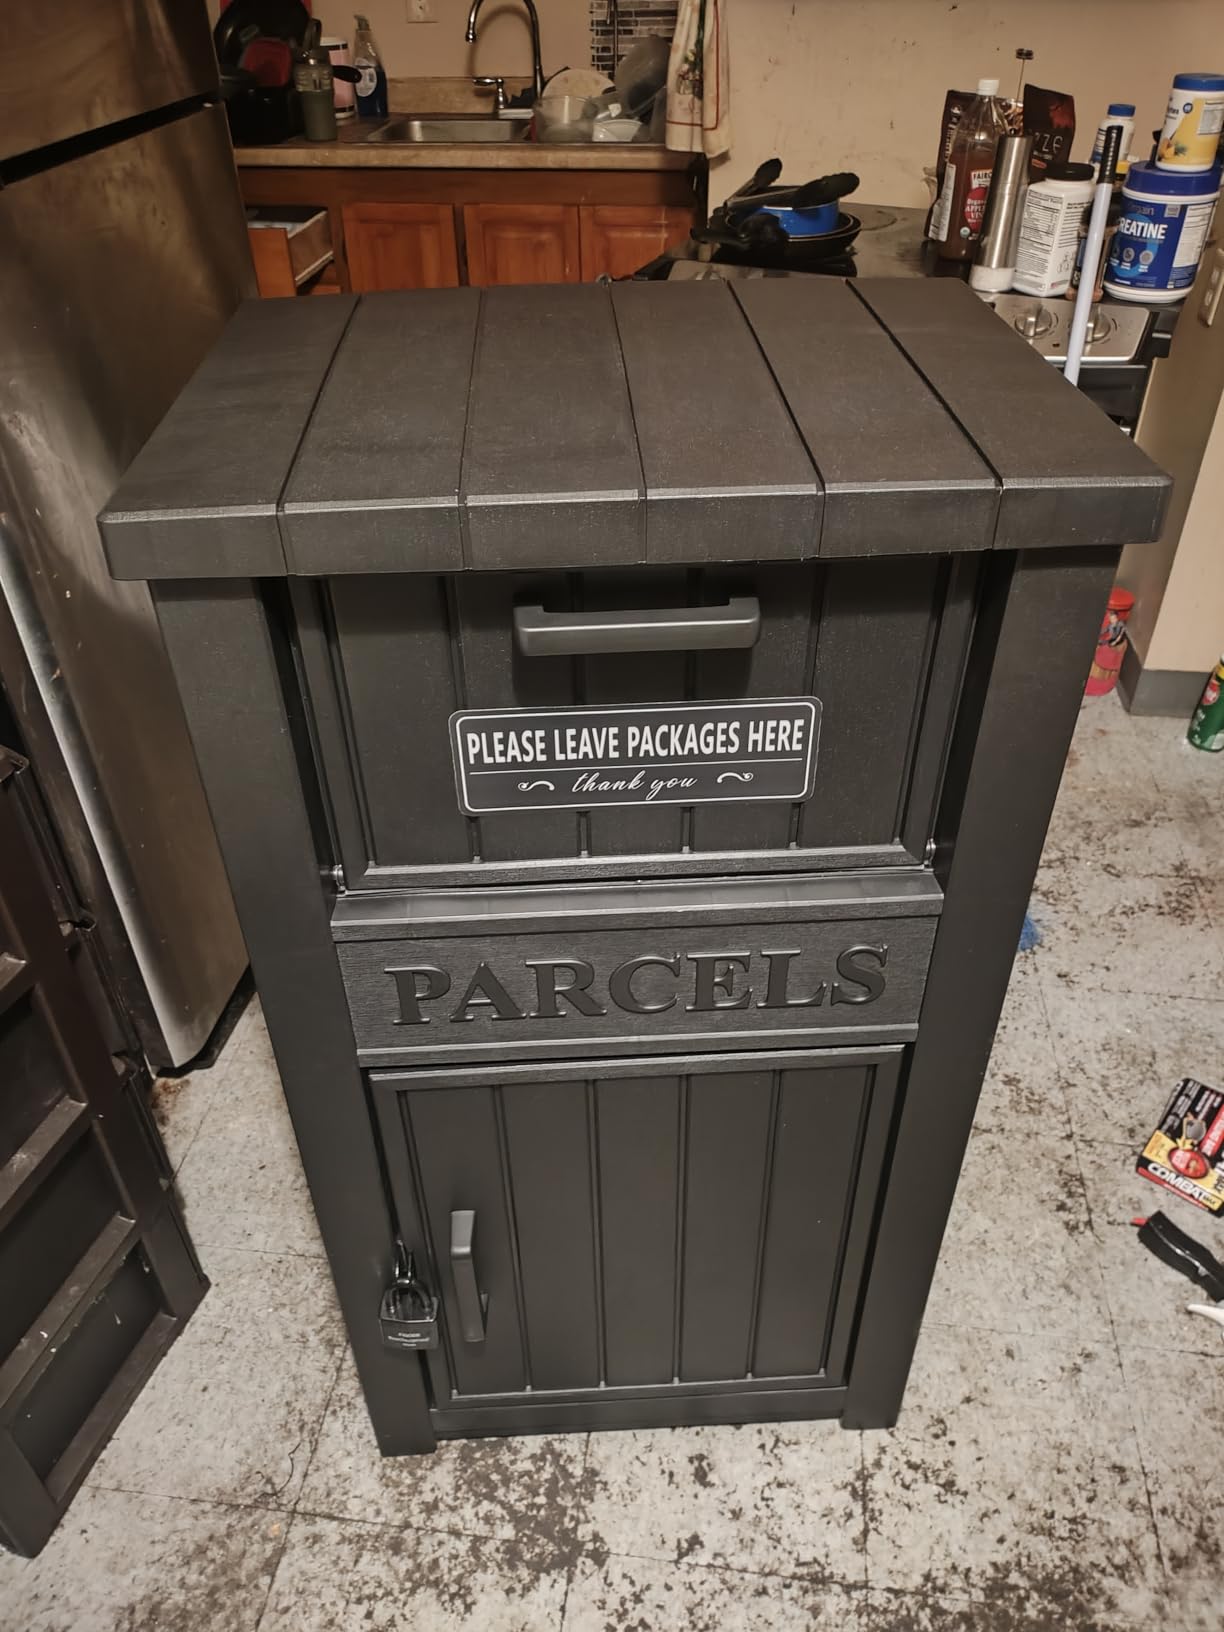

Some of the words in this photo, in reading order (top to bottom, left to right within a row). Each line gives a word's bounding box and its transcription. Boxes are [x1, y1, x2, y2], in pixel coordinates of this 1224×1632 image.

[466, 730, 547, 765] PLEASE
[553, 726, 620, 761] LEAVE
[627, 721, 741, 758] PACKAGES
[747, 718, 805, 753] HERE
[571, 769, 646, 793] thank
[645, 775, 698, 801] you
[383, 942, 889, 1026] PARCELS
[1147, 1162, 1209, 1200] COMBAT
